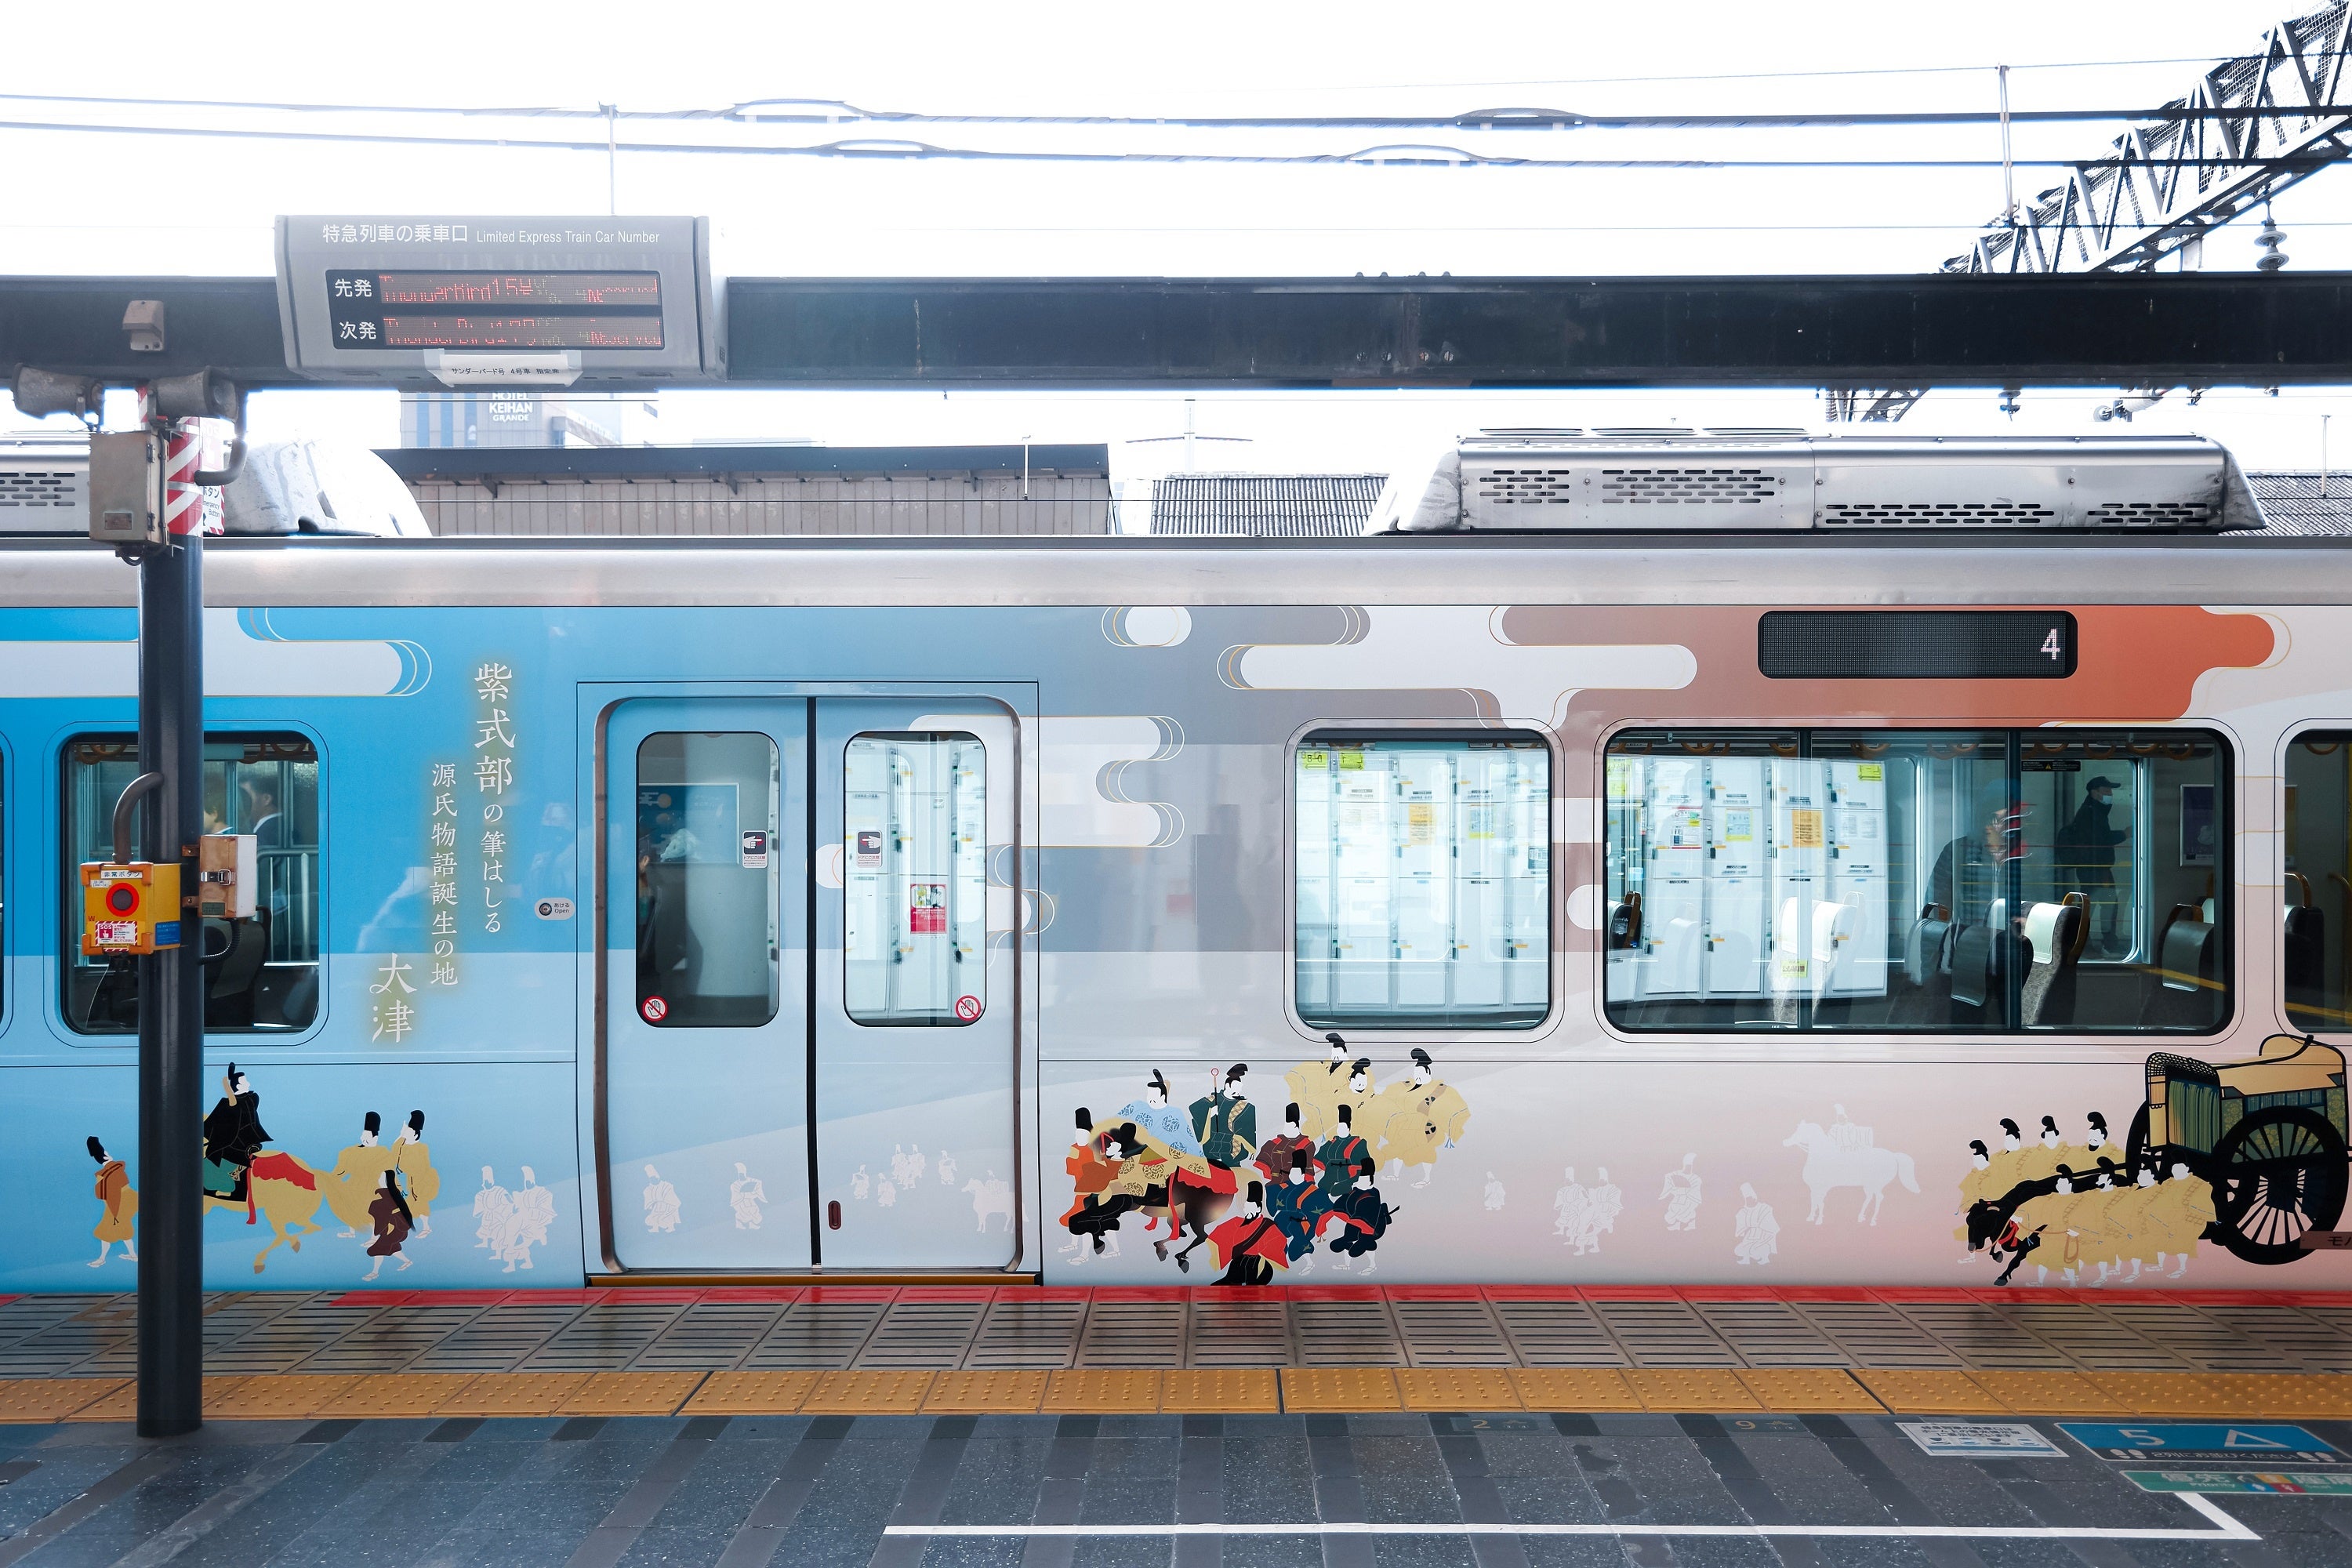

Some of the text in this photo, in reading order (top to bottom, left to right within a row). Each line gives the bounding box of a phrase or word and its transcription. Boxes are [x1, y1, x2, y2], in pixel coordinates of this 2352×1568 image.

[322, 223, 468, 243] 特急列車の乗車口
[476, 230, 659, 245] Limited Express Train Car Number
[335, 278, 372, 297] 先発
[339, 321, 377, 340] 次発
[489, 402, 533, 413] KEIHAN
[2040, 629, 2060, 660] 4
[474, 662, 516, 934] 紫式部の筆はしる
[430, 763, 459, 985] 源氏物語誕生の地
[369, 953, 418, 1044] 大津
[1471, 1420, 1491, 1428] 2
[1735, 1421, 1756, 1430] 9
[2118, 1429, 2165, 1446] 5
